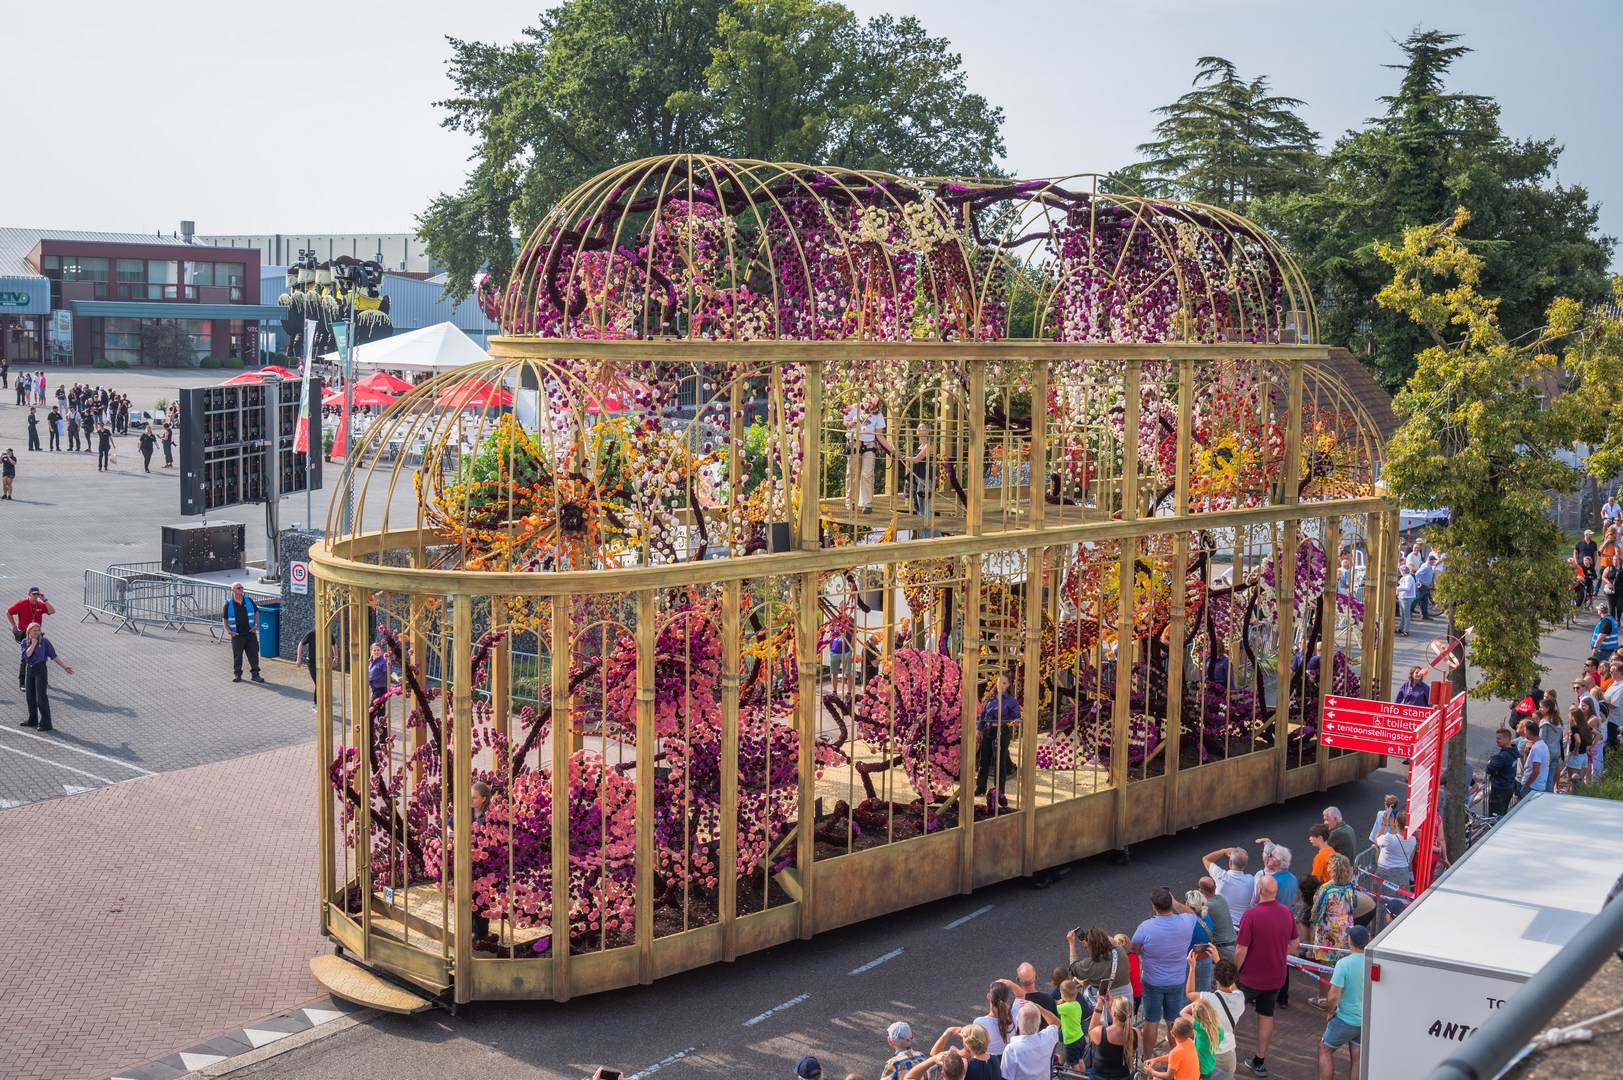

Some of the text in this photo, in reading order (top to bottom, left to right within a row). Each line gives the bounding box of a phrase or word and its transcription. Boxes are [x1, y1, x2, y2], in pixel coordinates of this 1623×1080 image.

[295, 569, 303, 577] 15
[1380, 704, 1431, 718] info stand
[1337, 723, 1413, 741] tentoonstellingster
[1428, 1019, 1478, 1042] ANT
